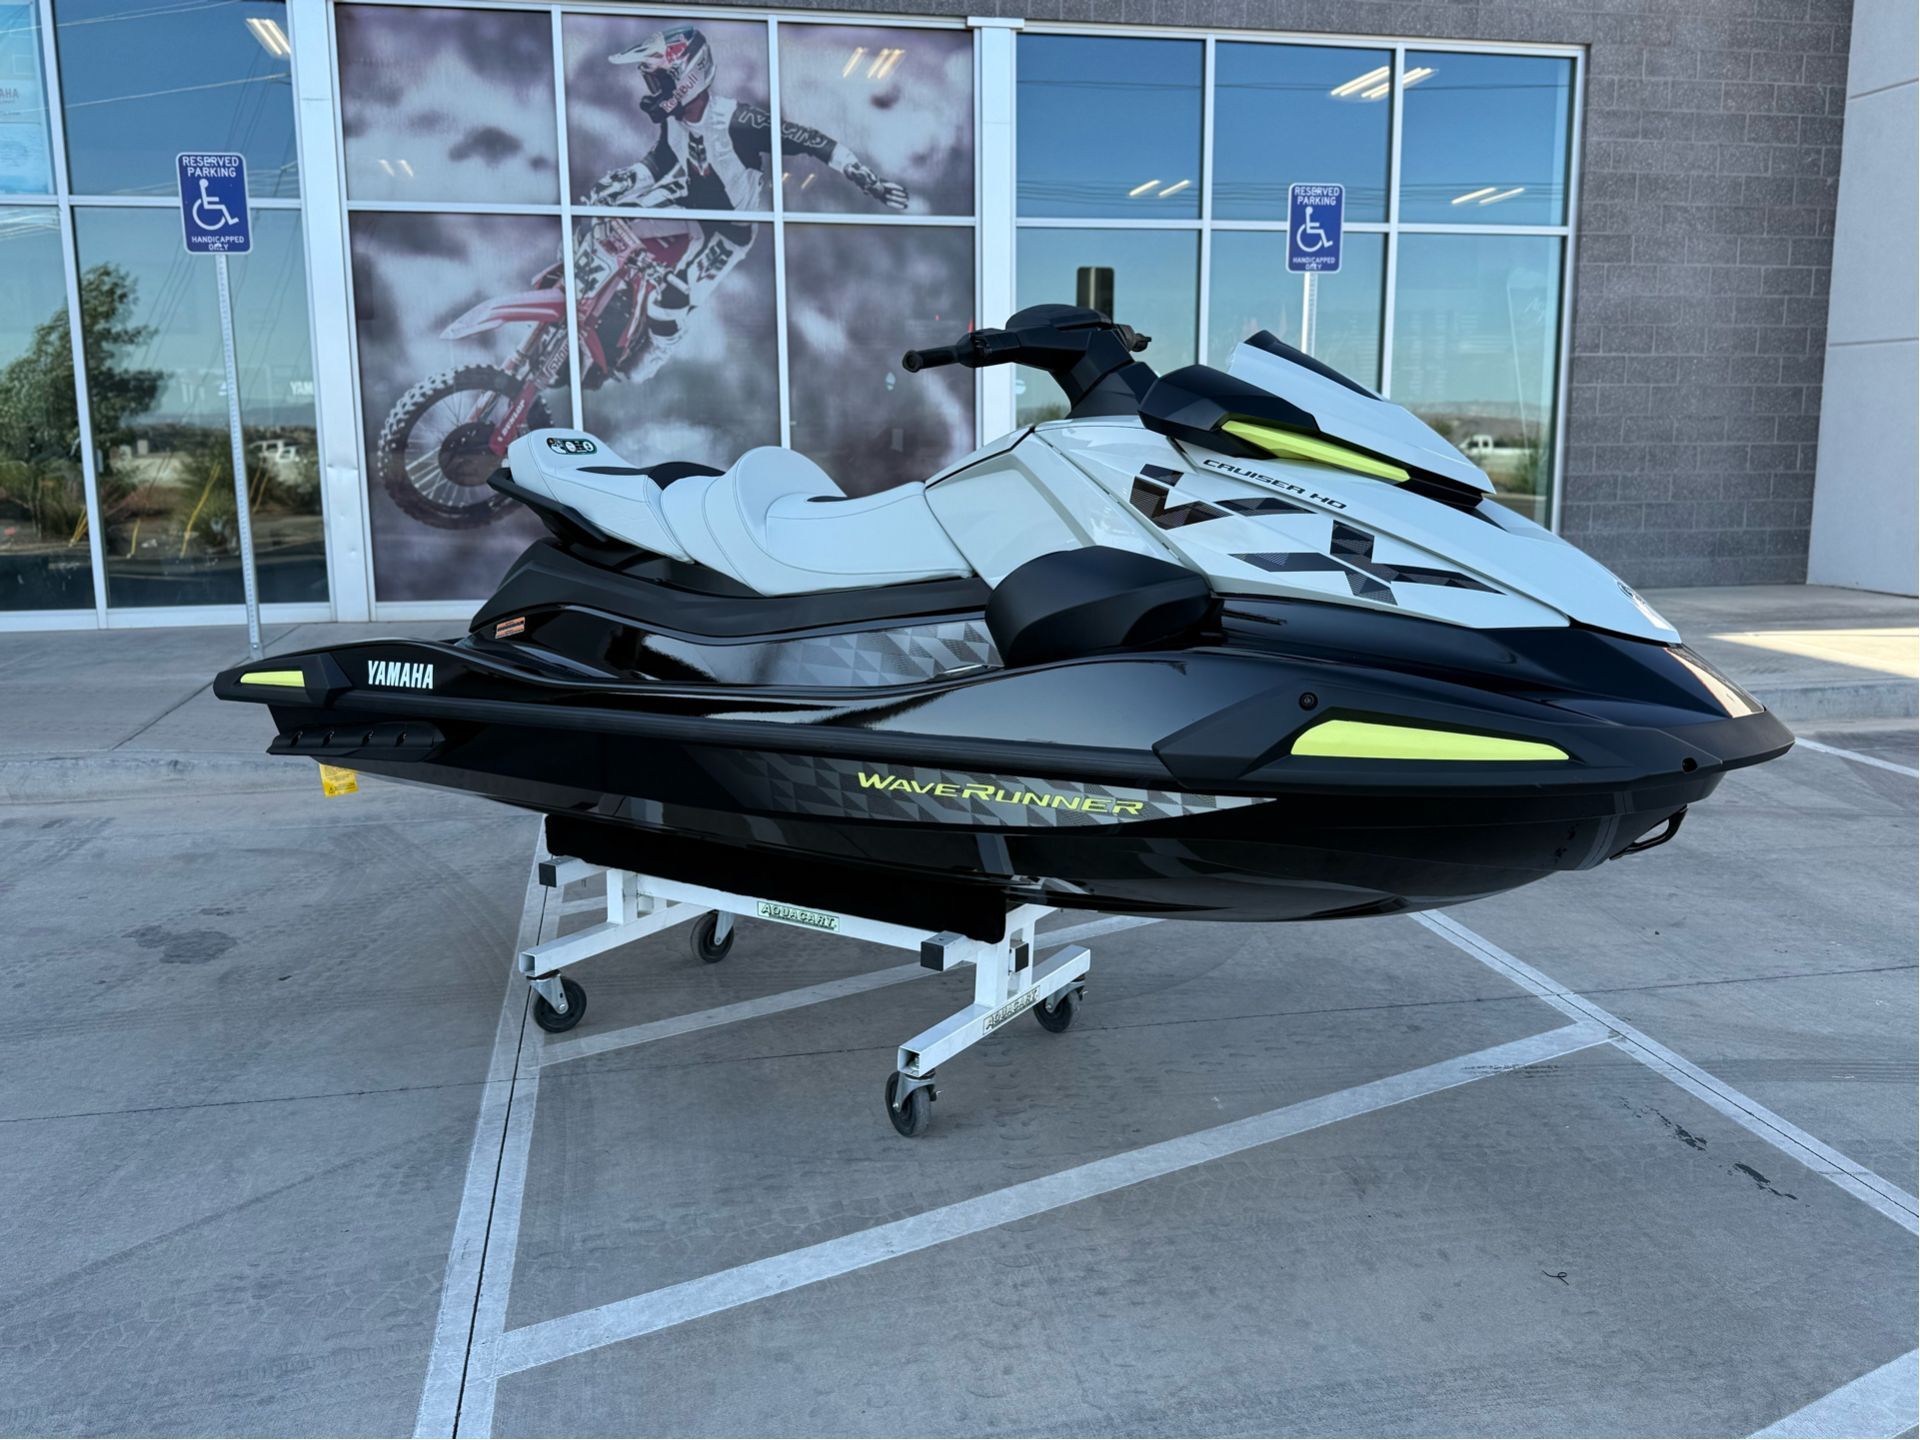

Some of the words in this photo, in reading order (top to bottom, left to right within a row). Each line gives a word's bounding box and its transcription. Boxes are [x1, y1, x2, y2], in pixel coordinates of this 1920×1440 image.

[182, 156, 239, 167] RESERVED
[187, 167, 237, 177] PARKING
[1294, 186, 1340, 197] RESERVED
[1297, 196, 1337, 206] PARKING
[1203, 459, 1306, 494] CRUISER
[1309, 493, 1347, 510] HO
[368, 660, 434, 690] YAMAHA
[857, 771, 1144, 815] WAVERUNNER
